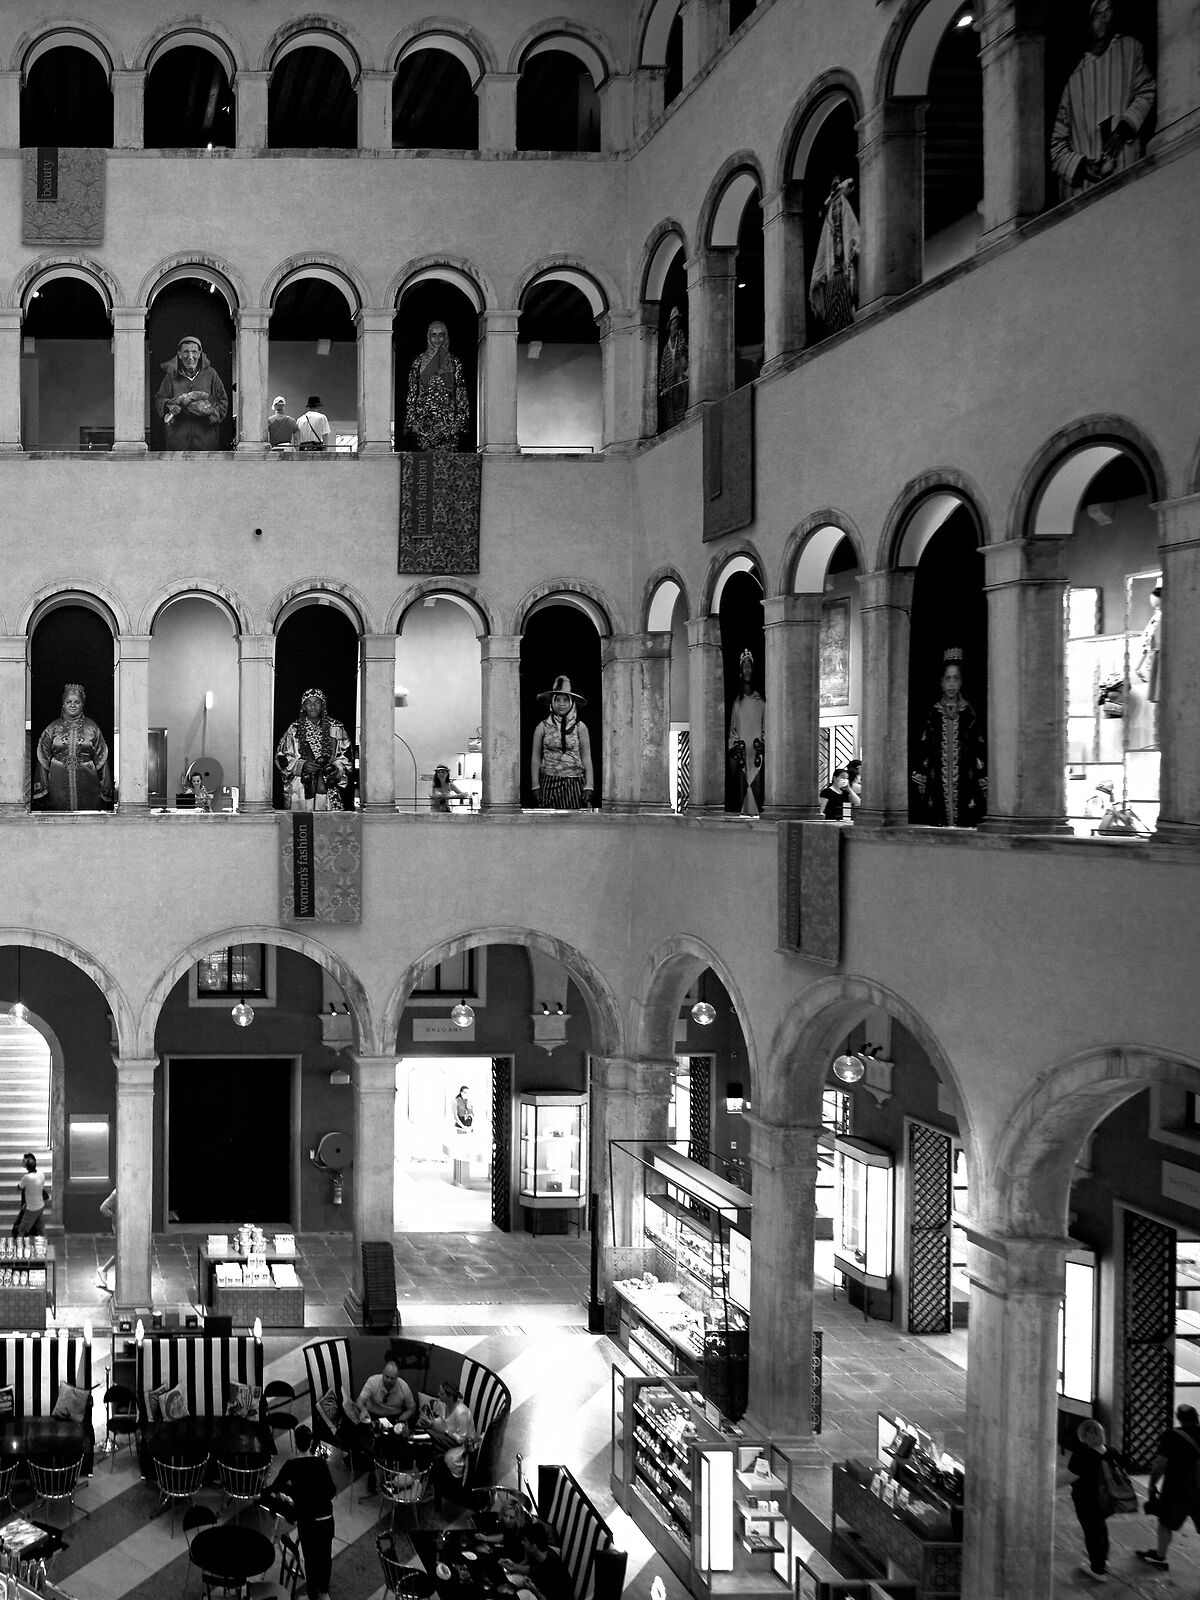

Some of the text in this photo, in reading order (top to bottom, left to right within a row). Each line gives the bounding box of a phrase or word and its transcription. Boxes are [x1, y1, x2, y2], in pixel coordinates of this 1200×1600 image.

[41, 160, 54, 197] beauty
[416, 460, 427, 534] men's fashion
[297, 824, 309, 914] women's fashion
